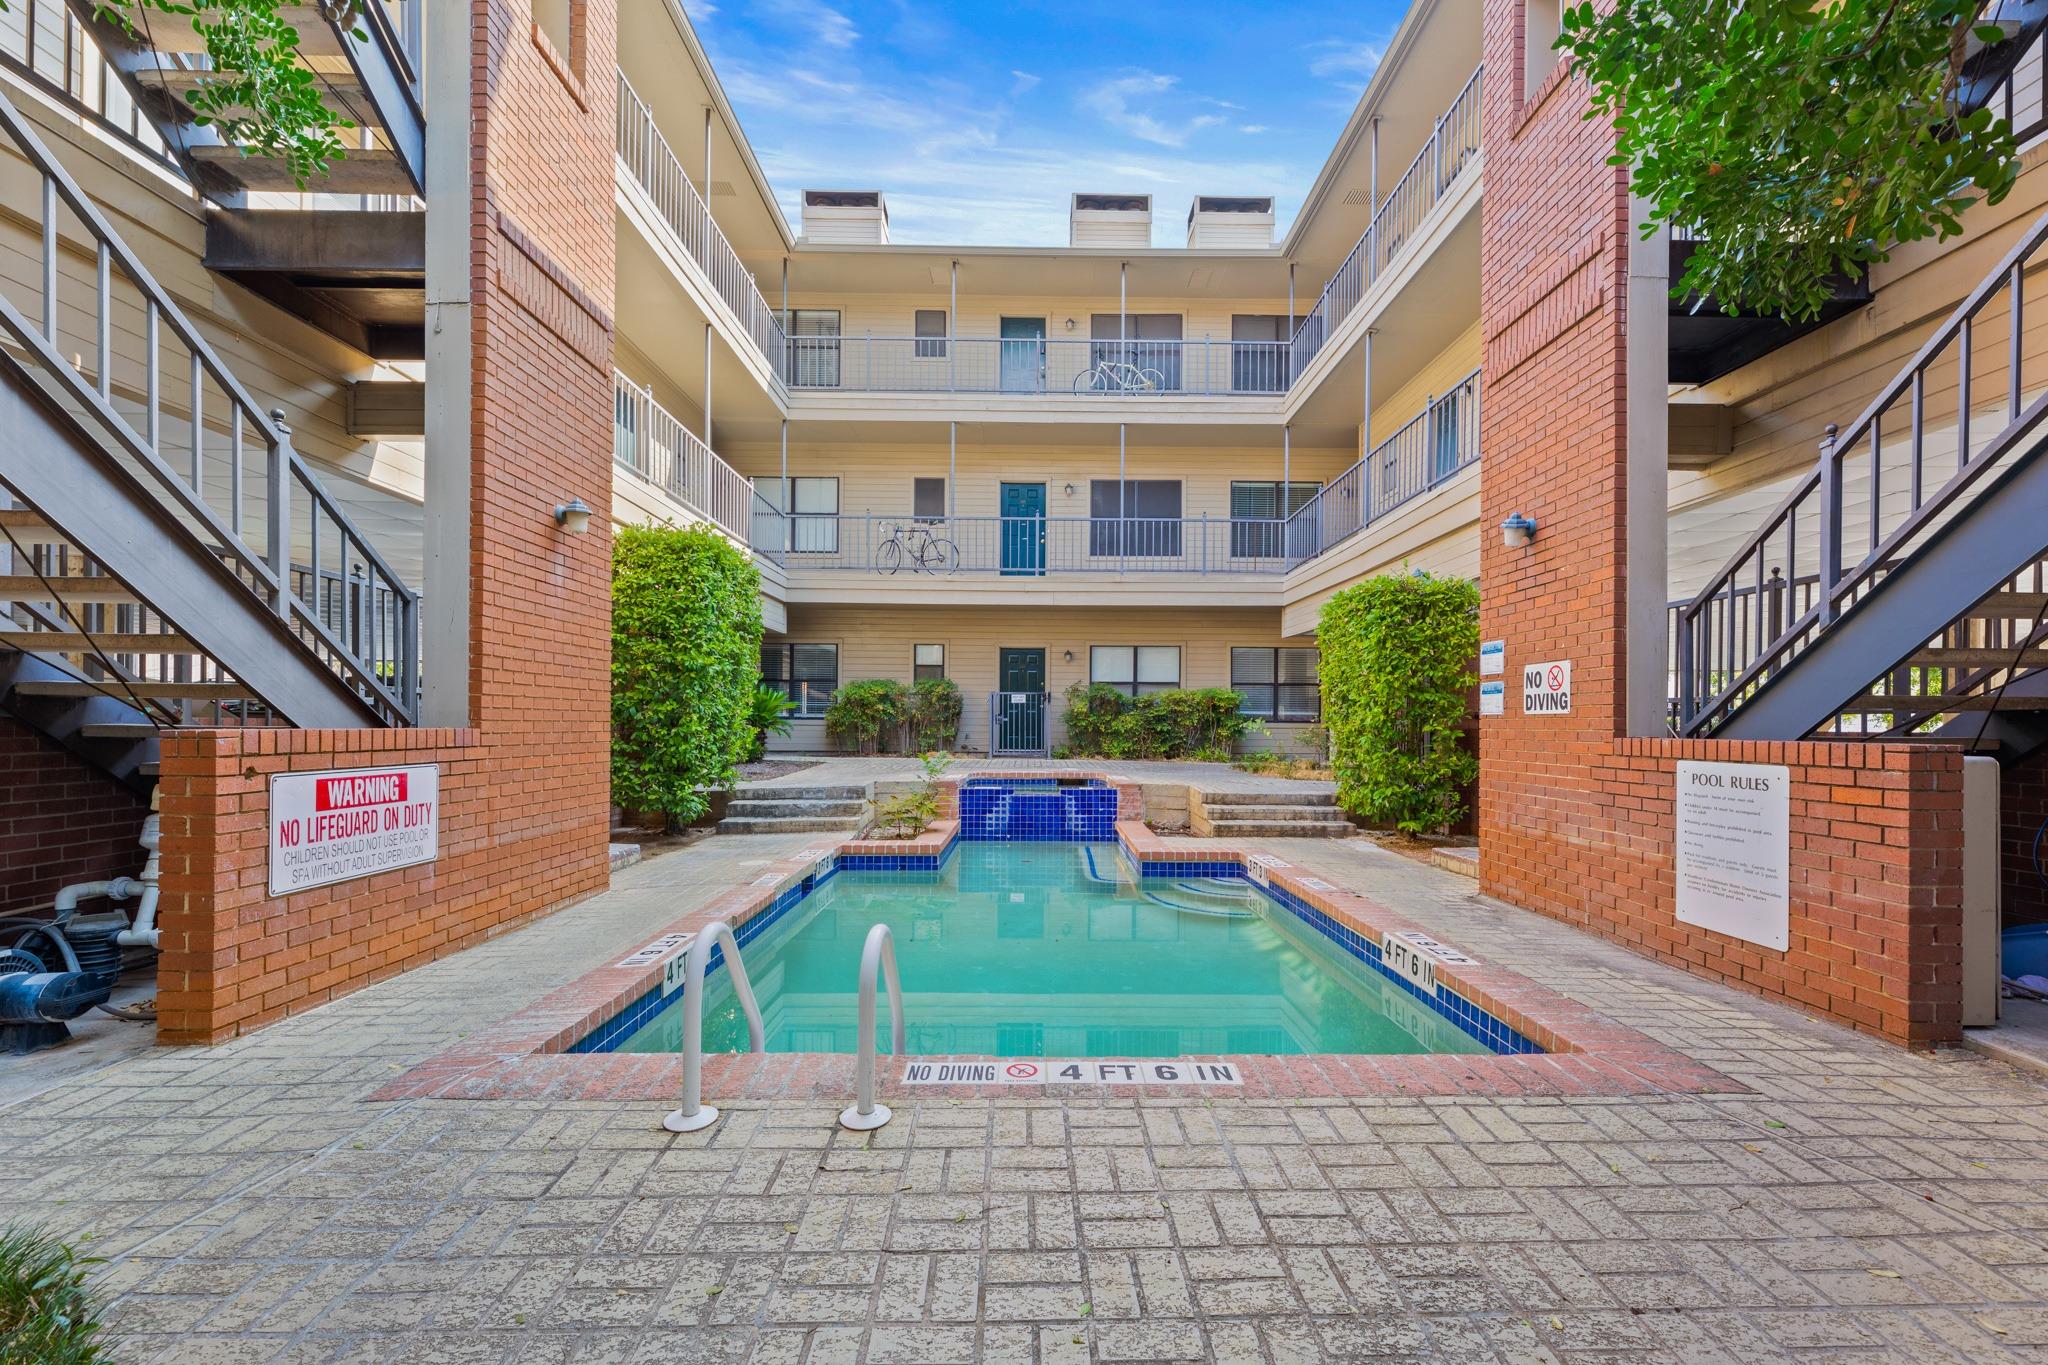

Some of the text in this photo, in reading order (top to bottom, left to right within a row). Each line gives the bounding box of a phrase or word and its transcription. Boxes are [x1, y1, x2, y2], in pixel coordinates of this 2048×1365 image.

[1525, 670, 1542, 689] NO
[1525, 692, 1568, 711] DIVING
[327, 775, 400, 808] WARNING
[1691, 773, 1769, 791] POOL RULES
[280, 802, 432, 848] NO LIFEGUARD ON DUTY
[284, 828, 429, 867] CHILDREN SHOULD NOT USE POOL OR
[292, 845, 423, 884] SPA WITHOUT ADULT SUPERVISION
[667, 961, 674, 984] 4
[1385, 939, 1435, 988] 4 FT 6 IN
[907, 1064, 1234, 1081] NO DIVING 4 FT 6 IN
